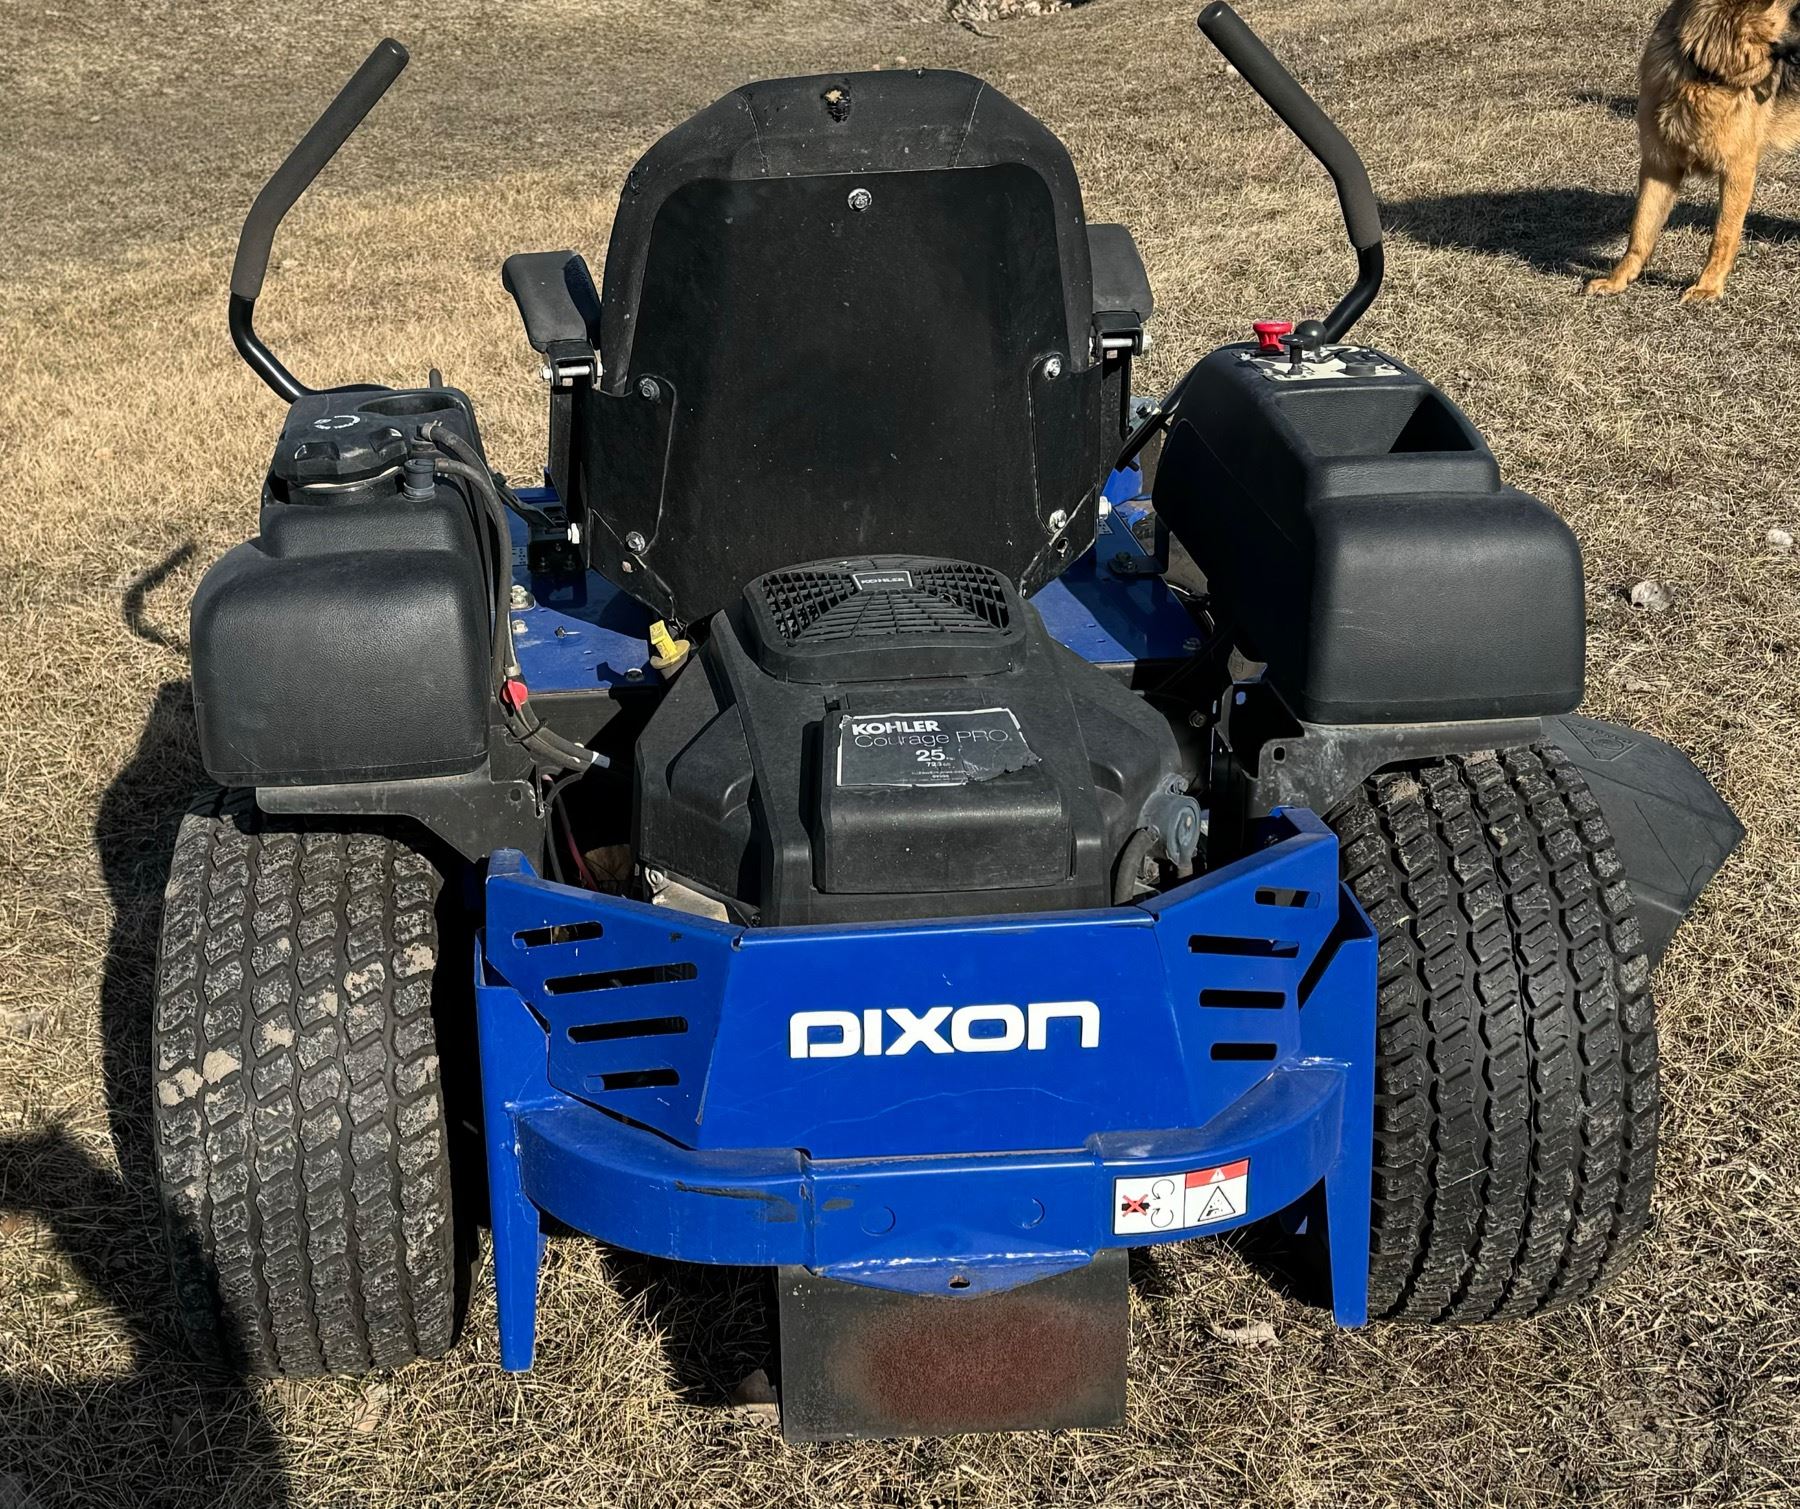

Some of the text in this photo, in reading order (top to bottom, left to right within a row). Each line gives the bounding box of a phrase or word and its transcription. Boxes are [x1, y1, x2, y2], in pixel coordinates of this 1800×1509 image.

[852, 720, 941, 735] KOHLER
[854, 733, 950, 748] Courage
[915, 749, 946, 762] 25
[789, 1000, 1100, 1059] DIXON
